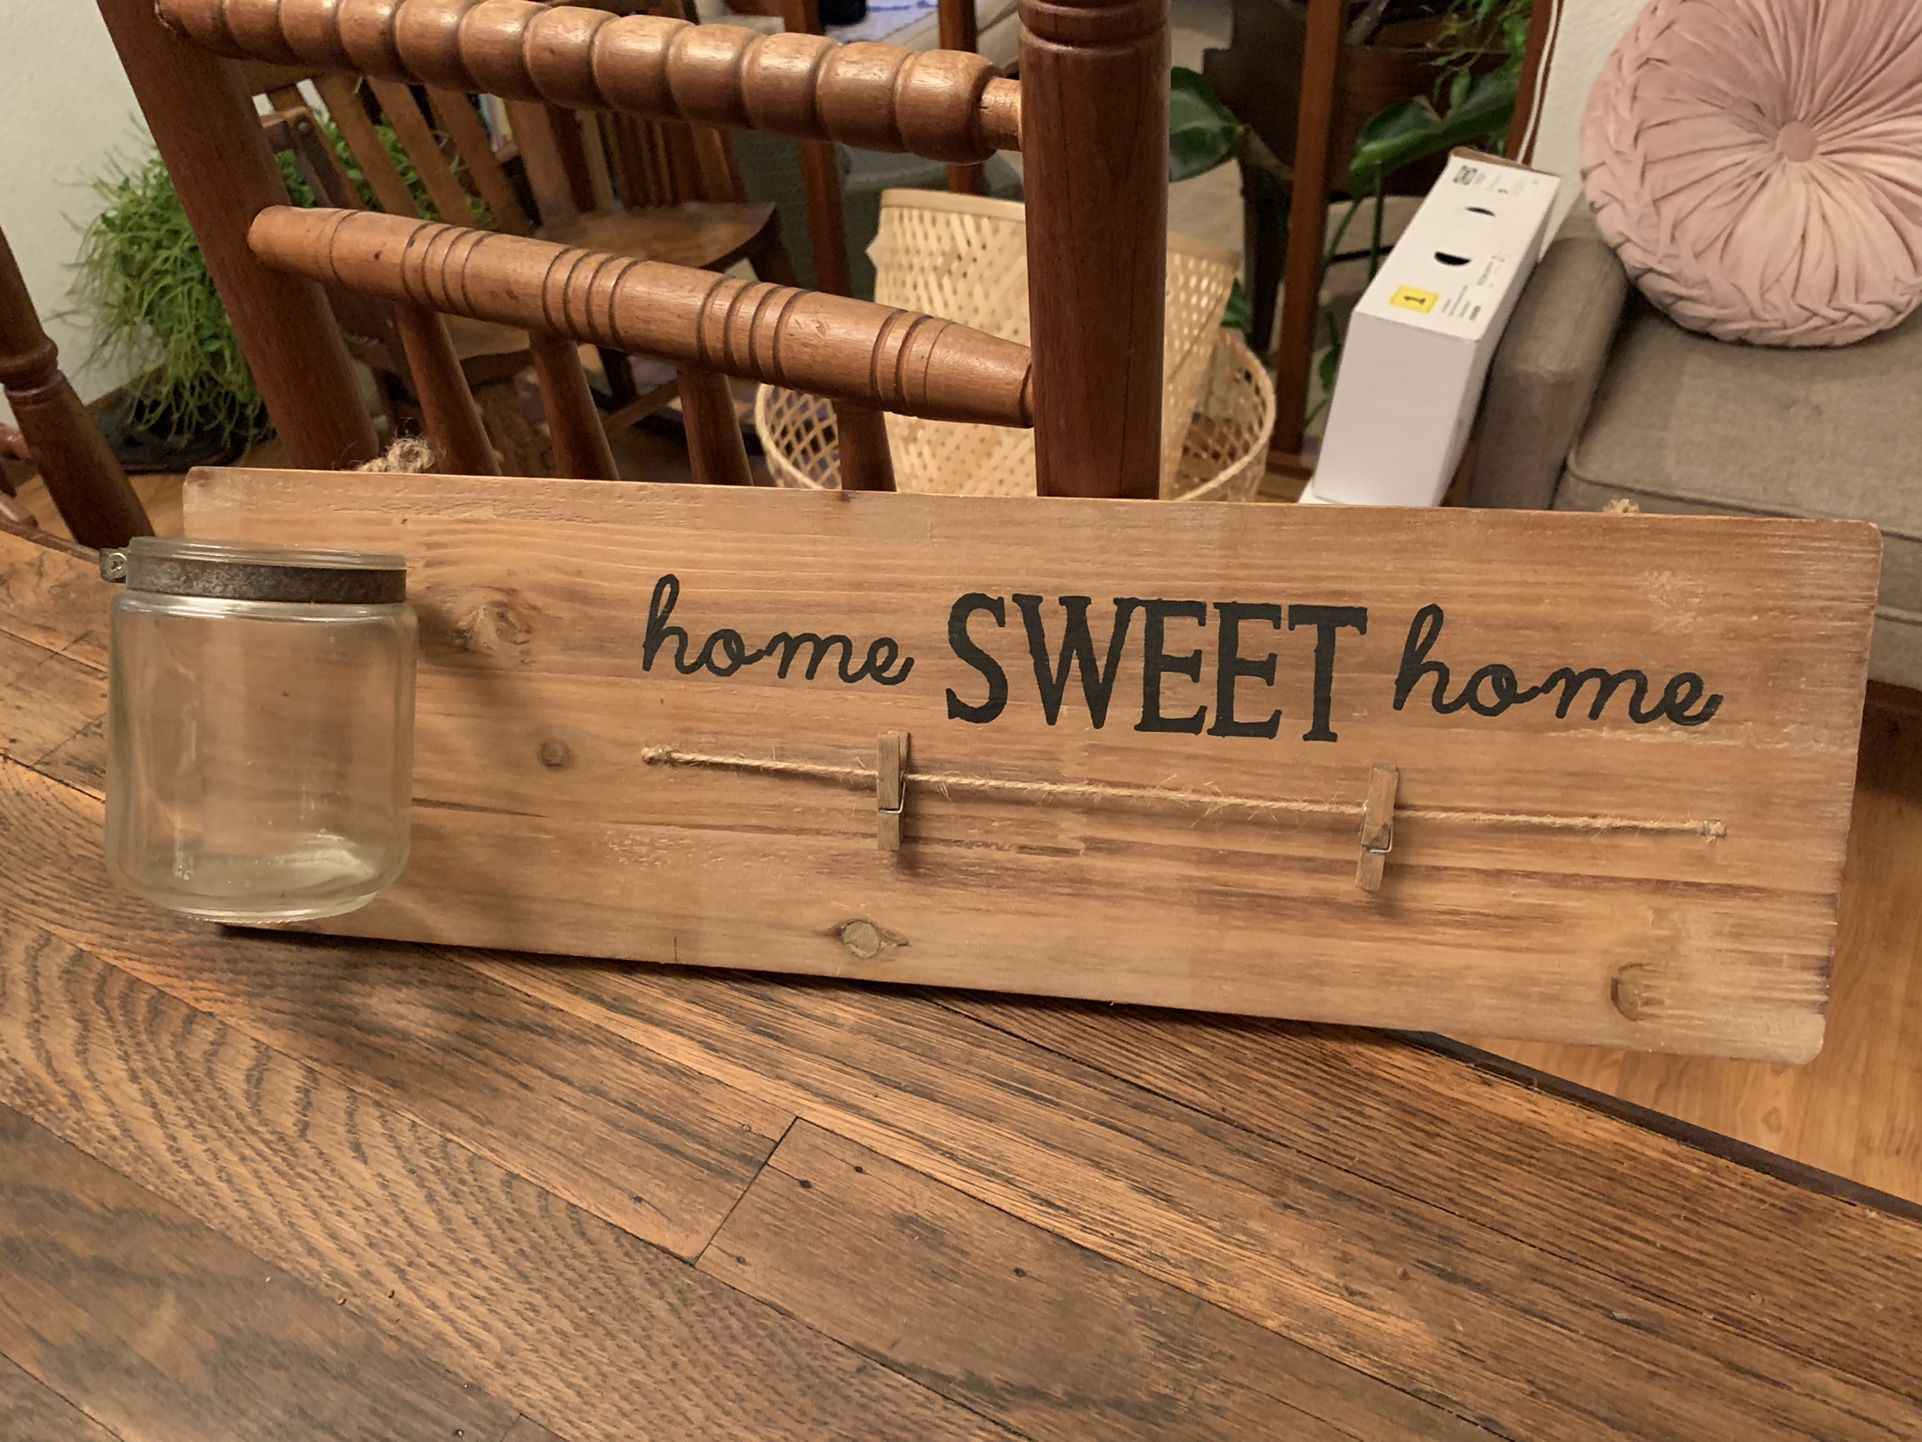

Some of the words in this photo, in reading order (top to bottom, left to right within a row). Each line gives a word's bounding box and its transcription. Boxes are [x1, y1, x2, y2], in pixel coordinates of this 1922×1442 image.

[1403, 294, 1427, 306] 1
[642, 574, 915, 686] home
[945, 592, 1368, 743] SWEET
[1392, 603, 1724, 727] home
